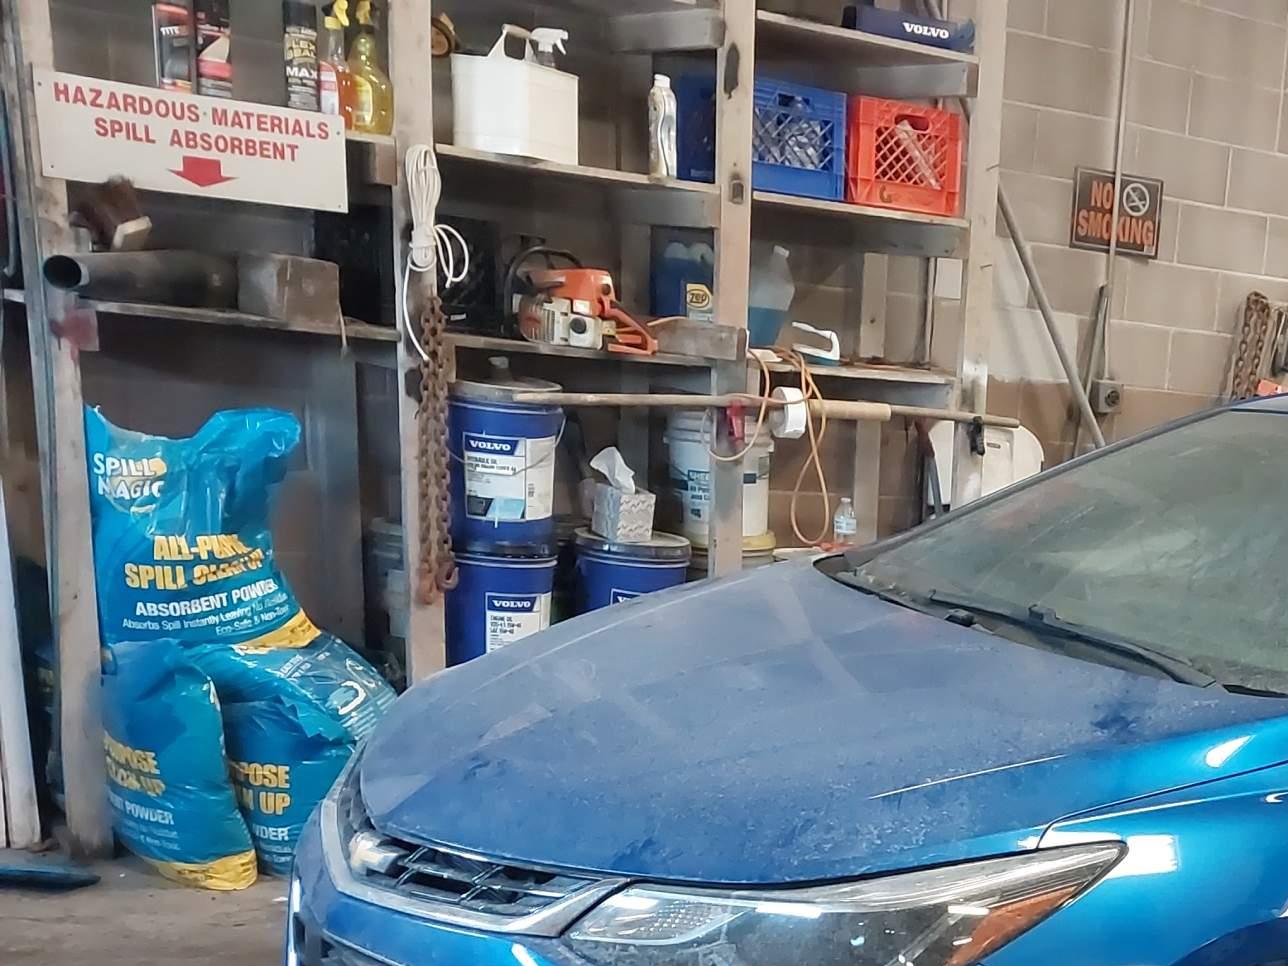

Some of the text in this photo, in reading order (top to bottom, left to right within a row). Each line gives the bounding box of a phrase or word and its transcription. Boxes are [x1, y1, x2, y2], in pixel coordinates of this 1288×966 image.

[902, 22, 949, 39] VOLVO
[286, 65, 317, 79] MAX
[53, 81, 330, 140] HAZARDOUS MATERIALS
[94, 117, 299, 162] SPILL ABSORBENT
[1091, 180, 1114, 210] NO
[1078, 209, 1154, 246] SMOKING
[469, 440, 512, 451] VOLVO
[93, 452, 155, 477] SPILL
[97, 475, 165, 500] MAGIC
[124, 562, 188, 590] SPILL
[135, 592, 228, 617] ABSORBENT
[492, 600, 531, 608] VOLVO
[124, 800, 175, 825] POWDER
[259, 791, 291, 815] UP
